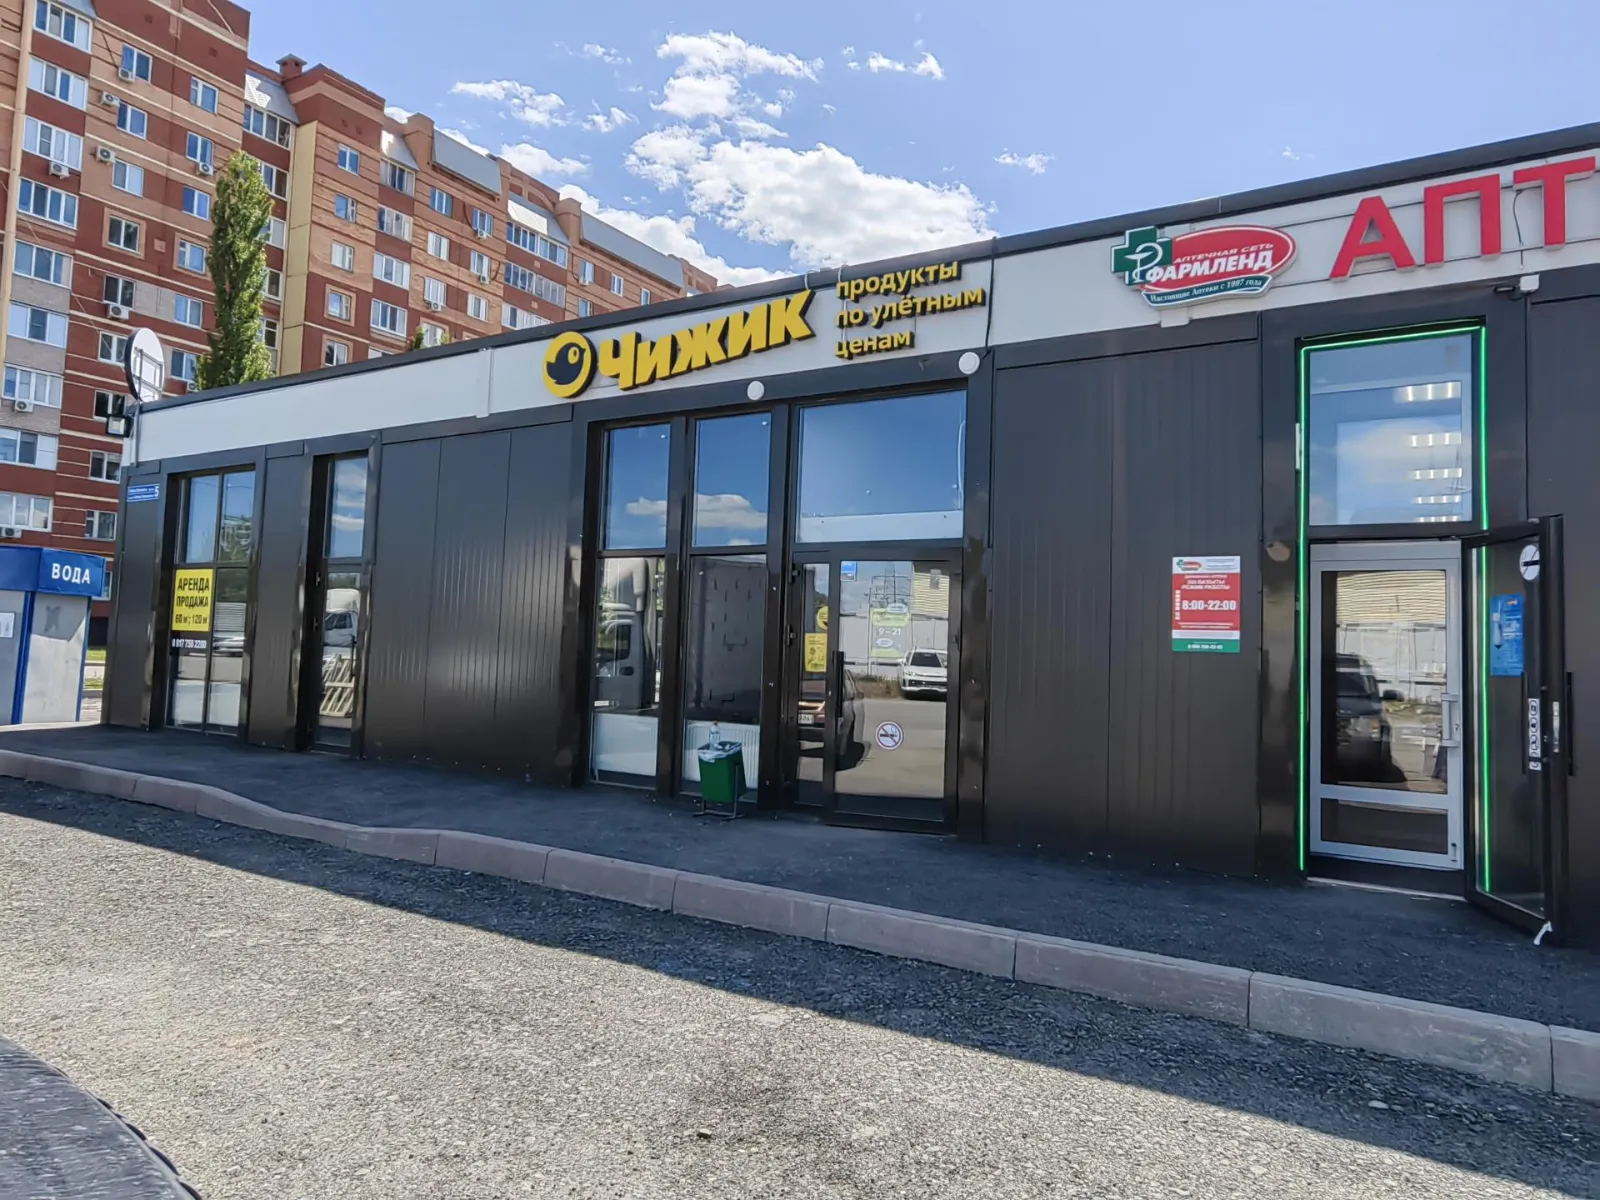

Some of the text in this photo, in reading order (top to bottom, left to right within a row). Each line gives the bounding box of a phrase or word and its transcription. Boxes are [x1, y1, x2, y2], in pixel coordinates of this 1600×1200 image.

[1329, 156, 1596, 280] АПТ
[1173, 242, 1274, 264] АПТЕЧНАЯ СЕТЬ
[1145, 250, 1273, 284] ФАРМЛЕНД
[835, 260, 961, 303] продукты
[1191, 284, 1219, 296] Аптеки
[1226, 278, 1245, 289] 1997
[1245, 278, 1263, 288] года
[834, 287, 986, 330] по улётным
[834, 330, 917, 360] ценам
[51, 562, 91, 584] ВОДА
[178, 577, 210, 593] АРЕНДА
[176, 595, 209, 609] ПРОДАЖА
